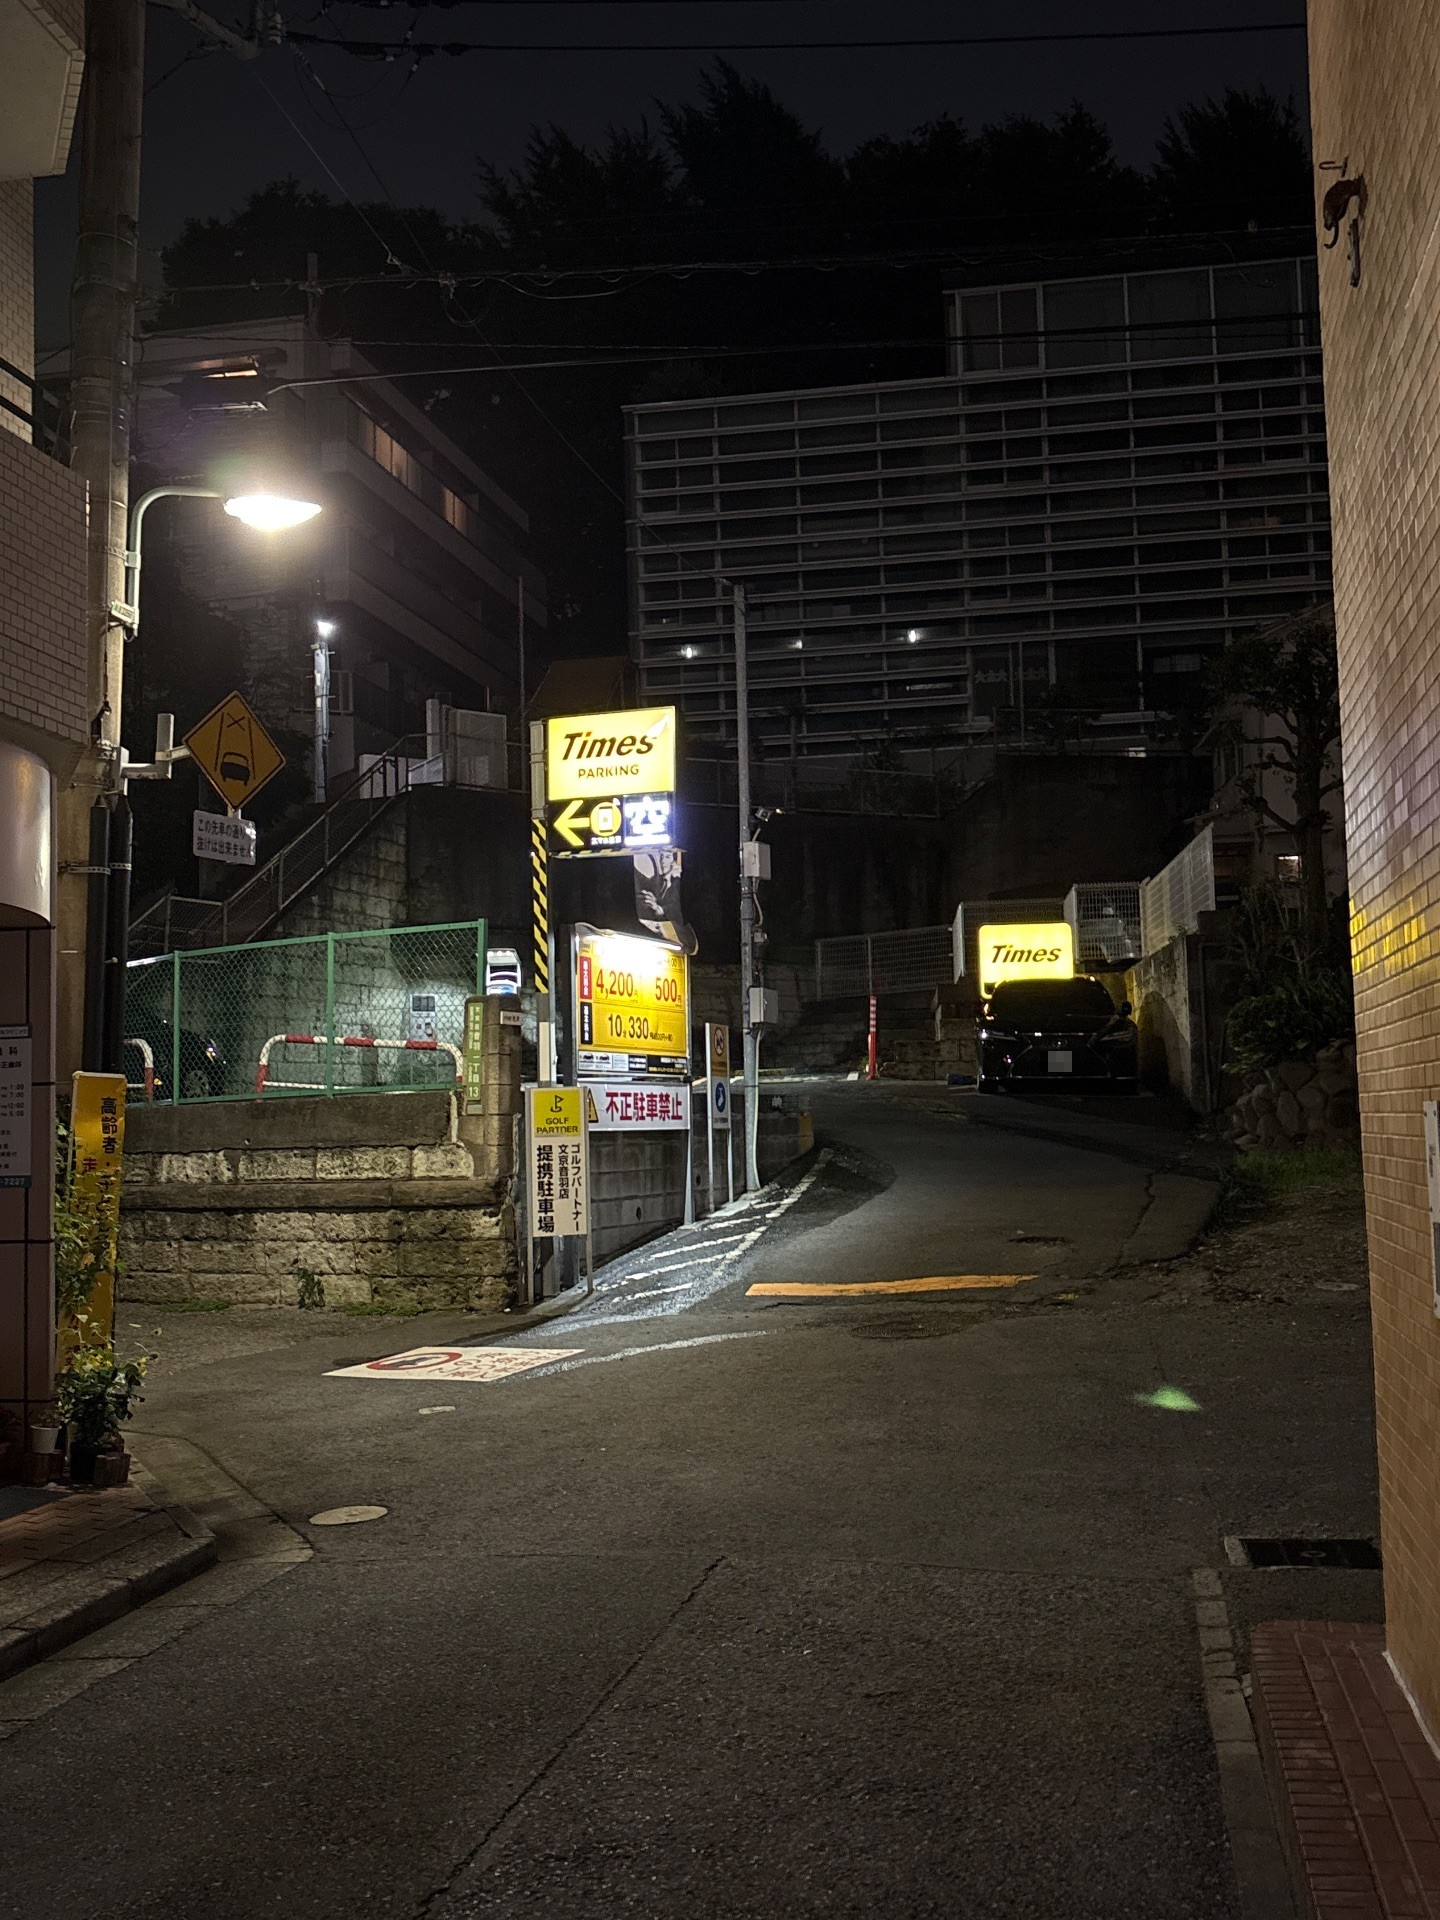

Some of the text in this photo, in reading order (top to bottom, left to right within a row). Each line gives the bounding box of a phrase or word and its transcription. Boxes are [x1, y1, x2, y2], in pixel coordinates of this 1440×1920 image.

[562, 731, 655, 760] Times
[578, 765, 639, 779] PARKING
[624, 796, 671, 846] 空
[991, 944, 1062, 963] Times
[468, 1086, 479, 1098] 13
[545, 1117, 569, 1125] GOLF
[605, 1092, 683, 1122] 不正駐車禁止
[536, 1126, 579, 1134] PARTNER
[558, 1143, 569, 1199] 文京音羽店
[536, 1144, 555, 1233] 提携駐車場
[571, 1143, 582, 1232] ゴルフパートナー
